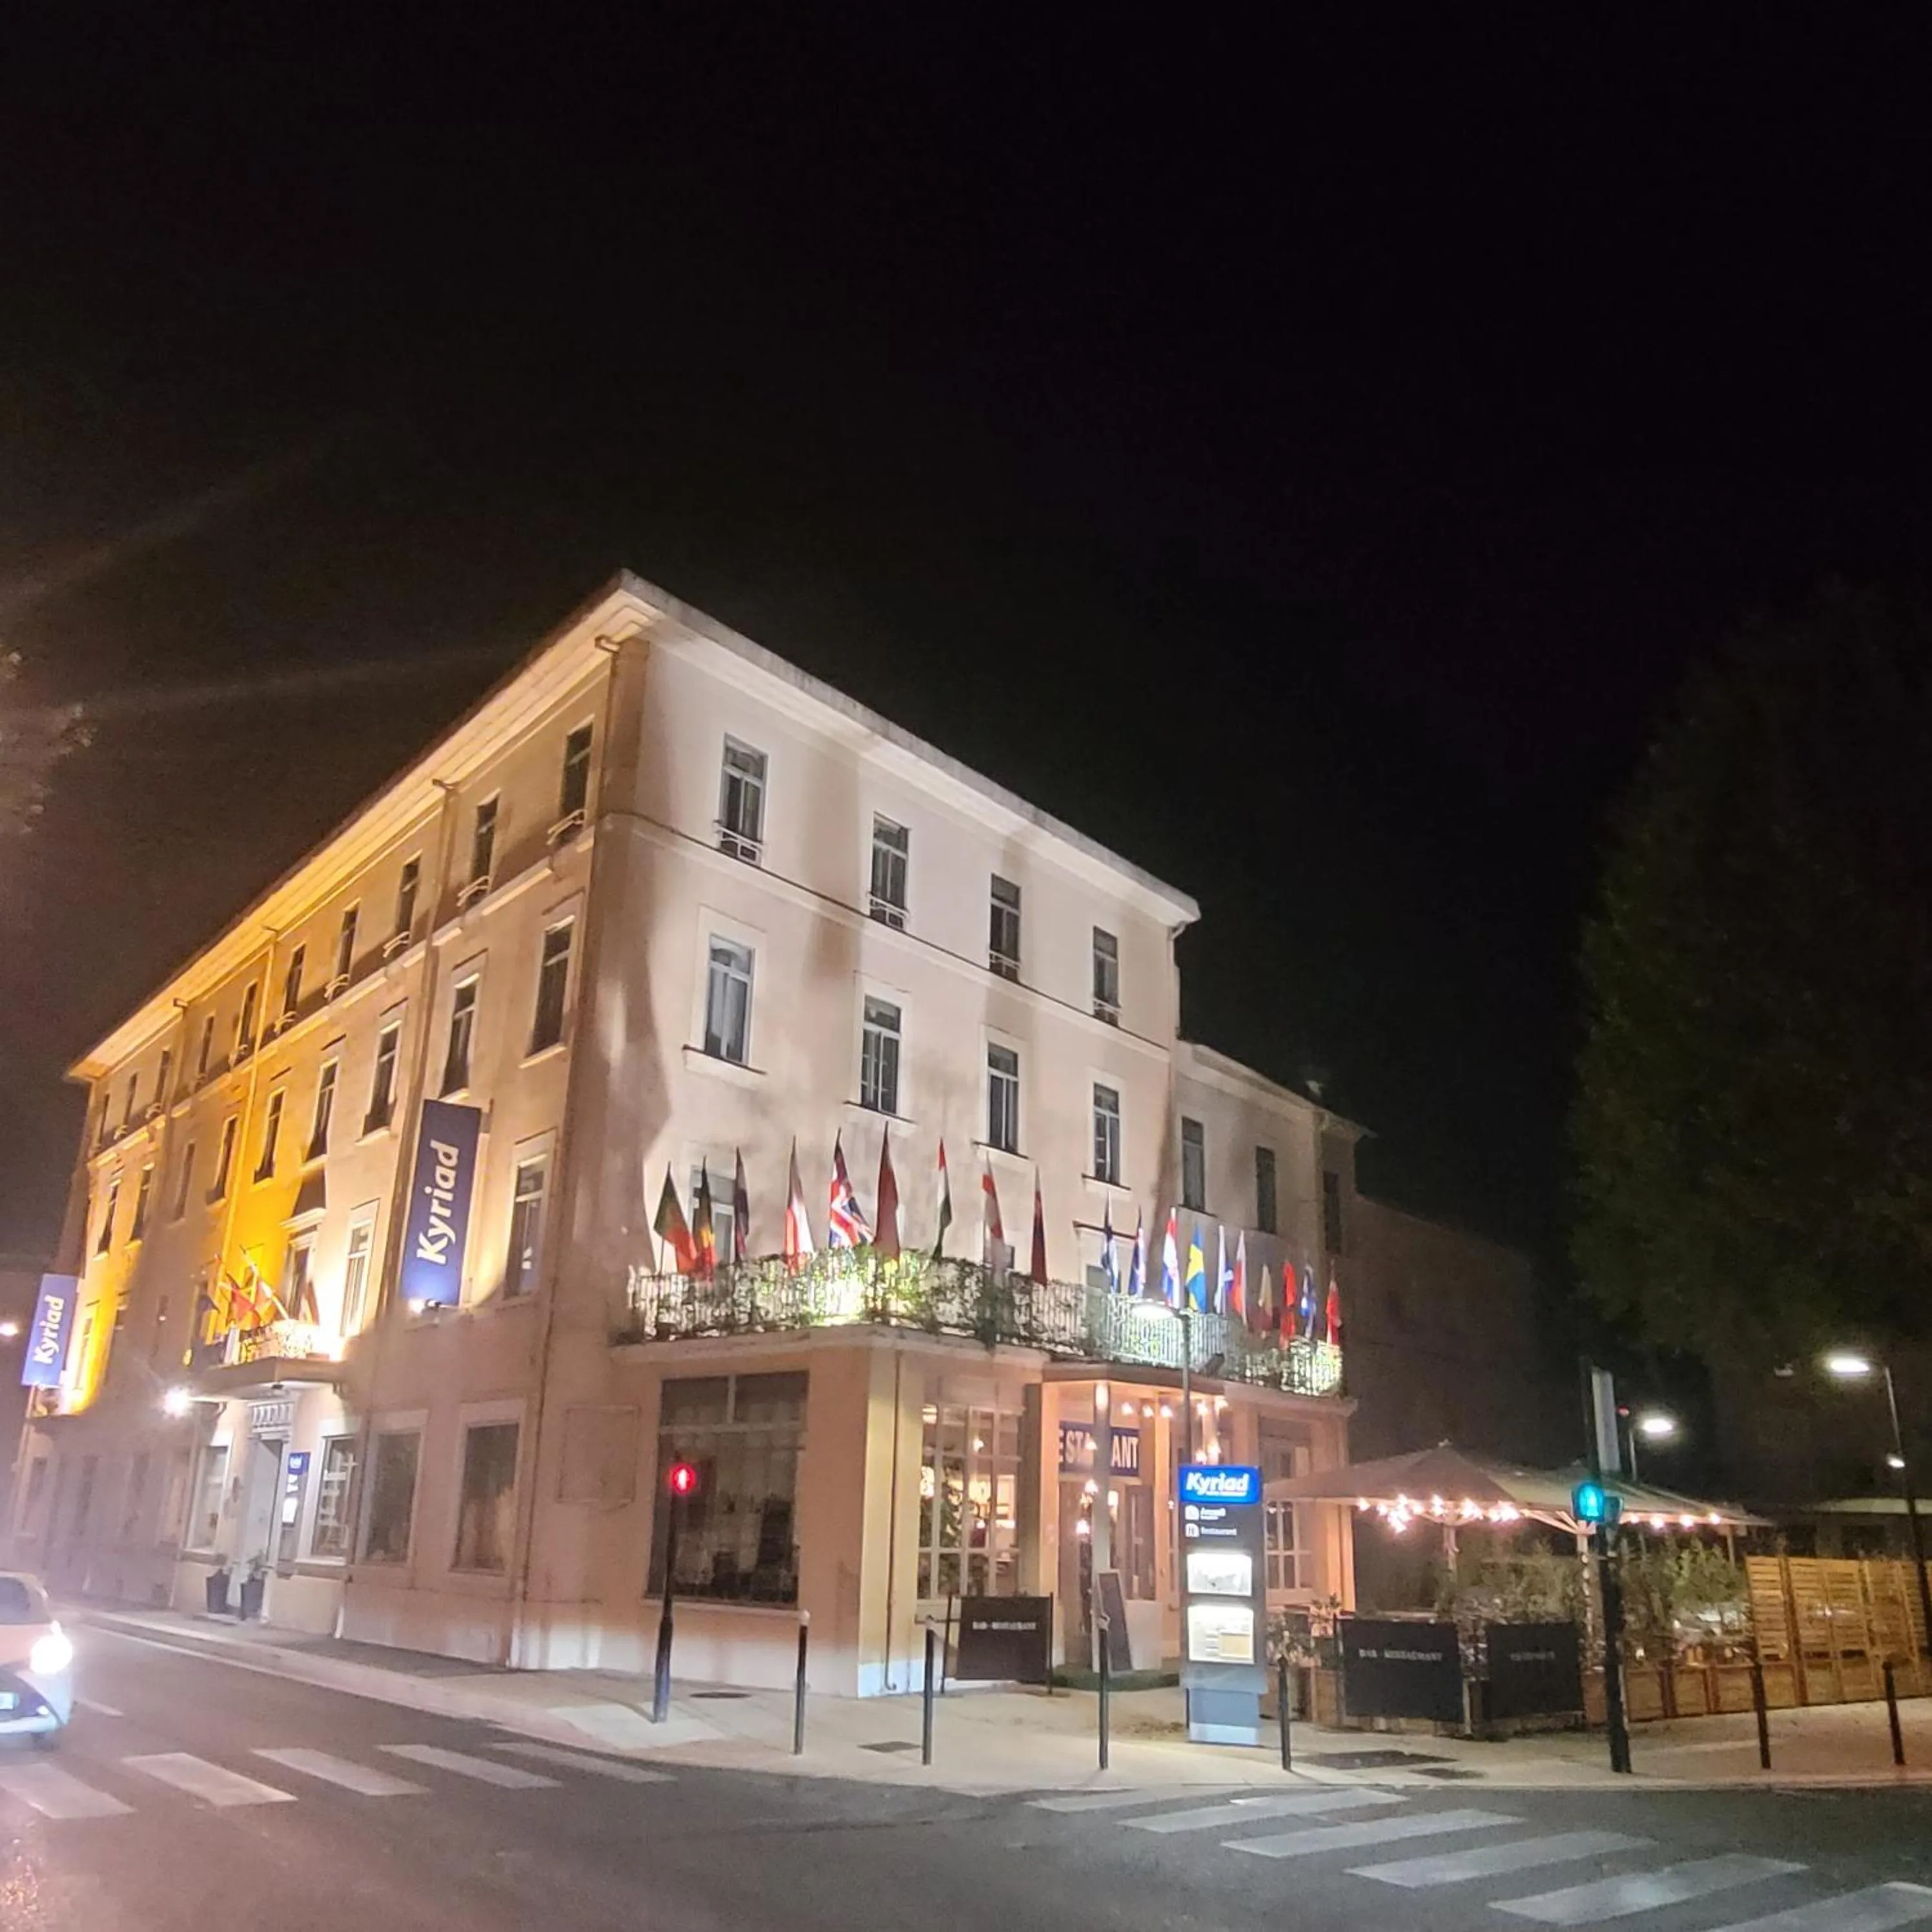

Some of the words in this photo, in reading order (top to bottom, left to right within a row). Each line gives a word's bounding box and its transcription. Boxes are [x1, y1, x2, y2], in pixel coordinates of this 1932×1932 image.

[416, 1139, 459, 1265] Kyriad
[33, 1295, 64, 1364] Kyriad
[1186, 1472, 1249, 1496] Kyriad
